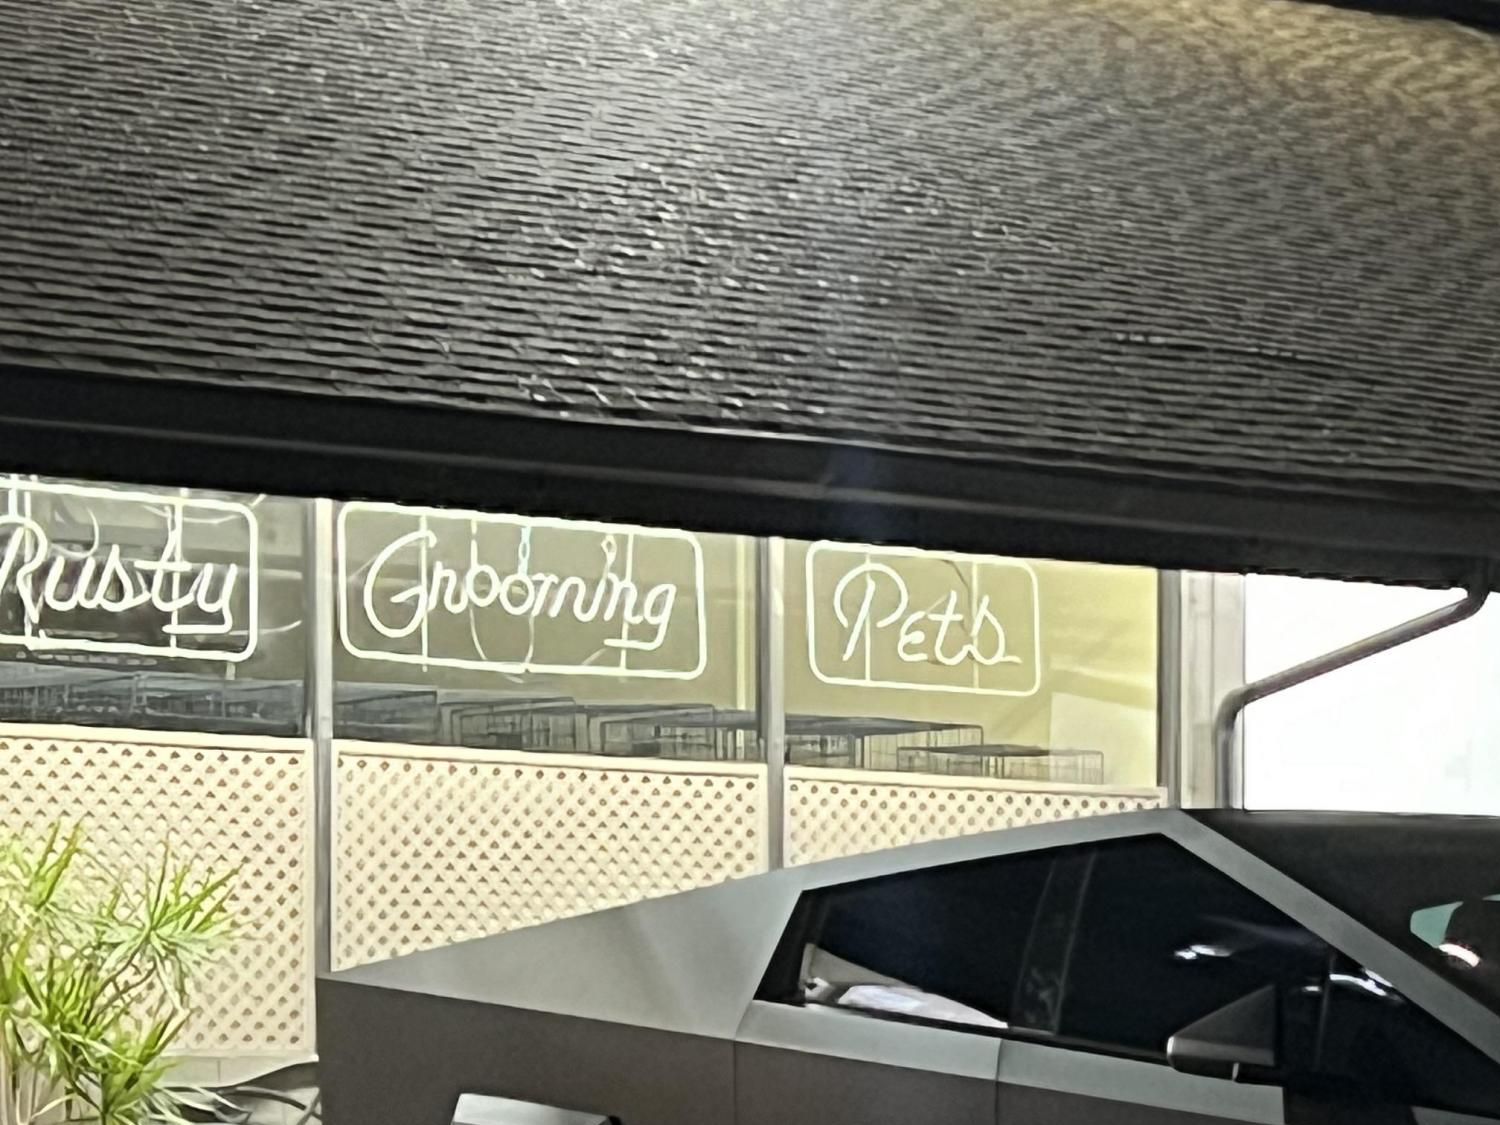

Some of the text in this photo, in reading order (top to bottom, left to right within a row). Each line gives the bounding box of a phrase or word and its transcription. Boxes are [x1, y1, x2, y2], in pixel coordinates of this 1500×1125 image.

[0, 514, 238, 634] Rusty
[364, 529, 677, 651] Grooming
[833, 562, 1022, 666] Pets
